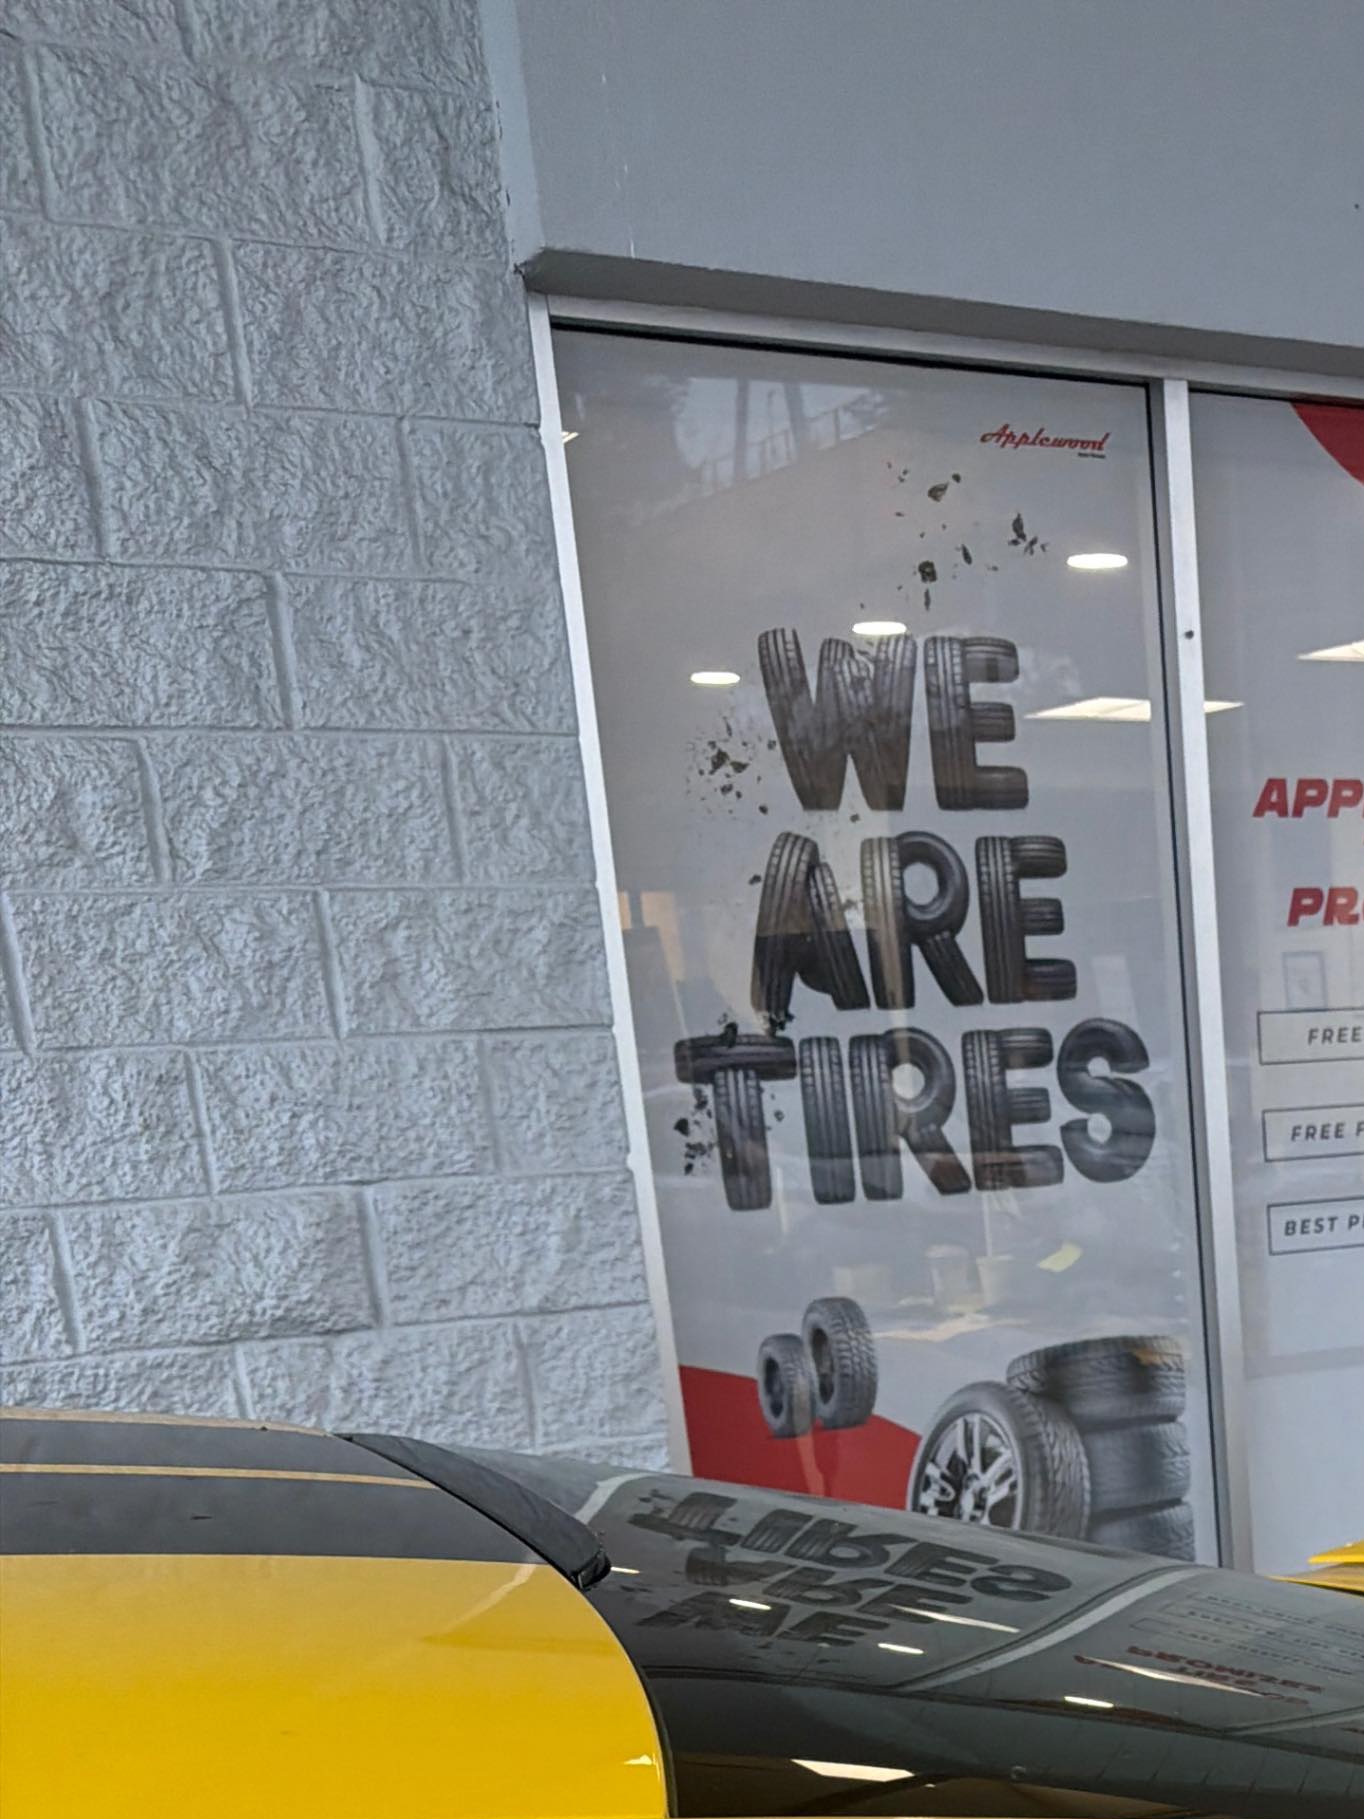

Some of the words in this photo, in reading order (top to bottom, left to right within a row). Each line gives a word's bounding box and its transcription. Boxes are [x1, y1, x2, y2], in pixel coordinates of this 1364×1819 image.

[980, 423, 1112, 451] Applewood
[758, 628, 1029, 811] WE
[750, 831, 1078, 1010] ARE
[1307, 1024, 1362, 1046] FREE
[674, 1018, 1156, 1212] TIRES
[1291, 1121, 1346, 1143] FREE
[1284, 1216, 1338, 1237] BEST
